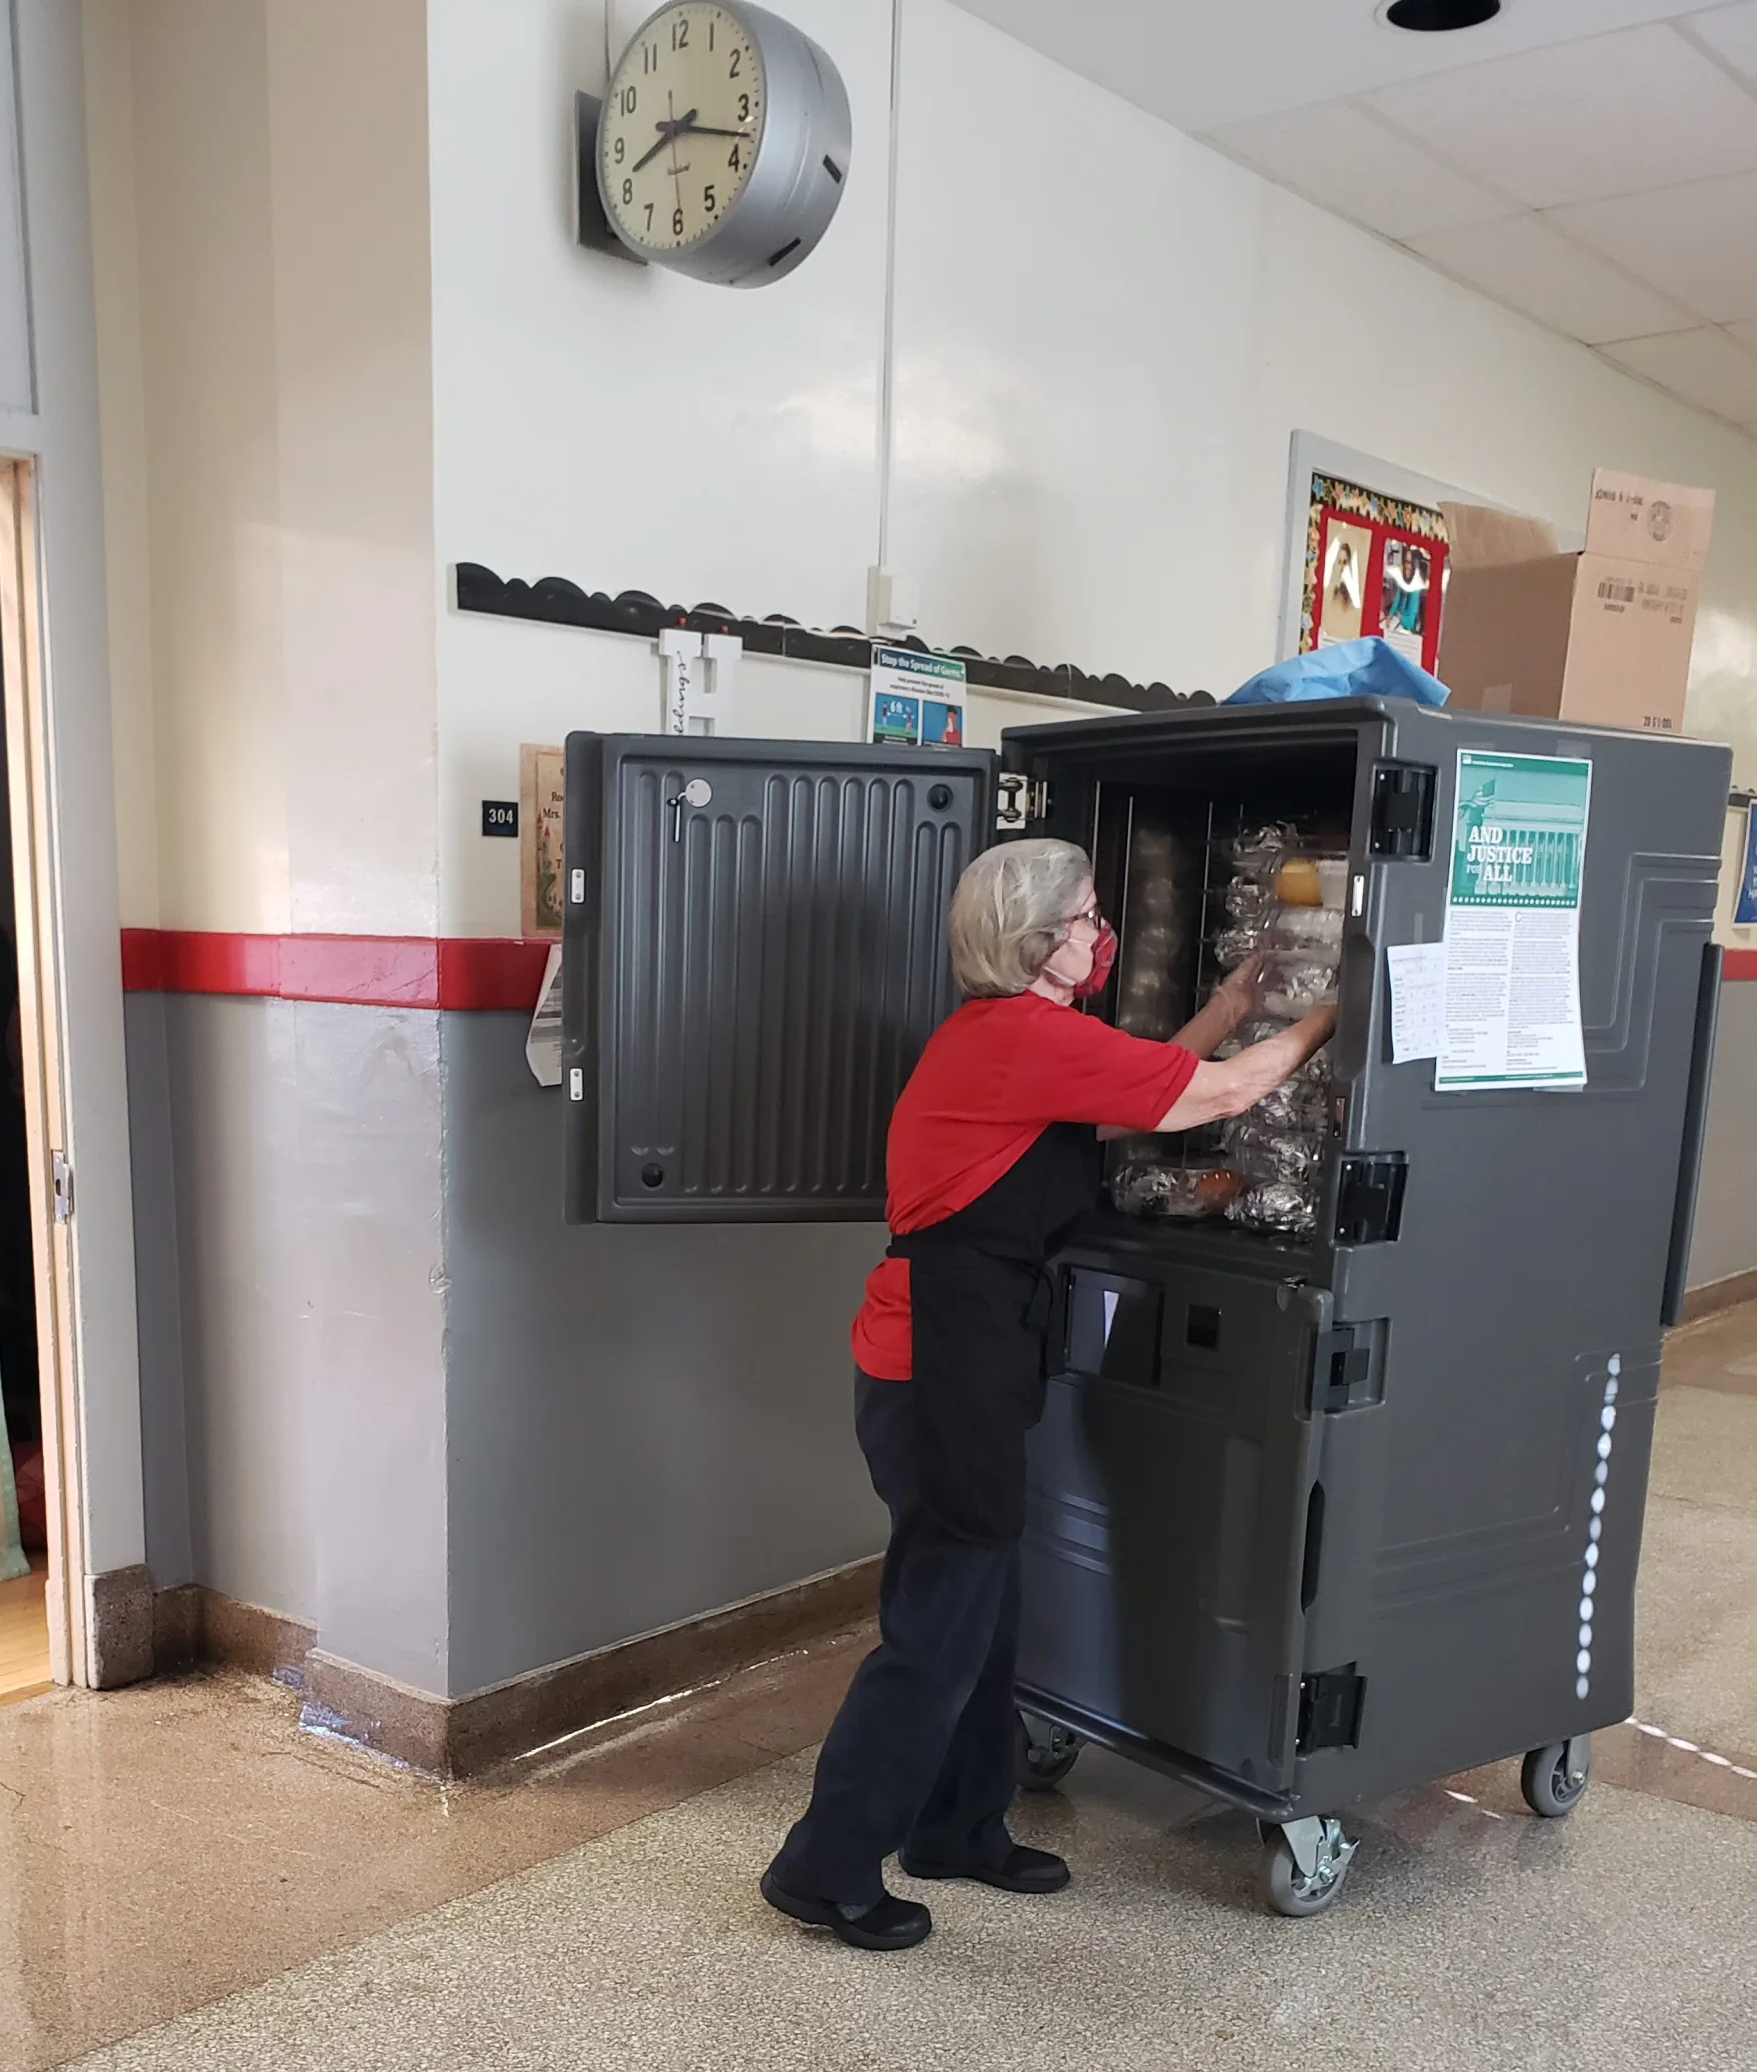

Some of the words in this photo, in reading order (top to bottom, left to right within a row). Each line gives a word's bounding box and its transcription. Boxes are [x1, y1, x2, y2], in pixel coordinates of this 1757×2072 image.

[672, 19, 689, 51] 12
[709, 22, 714, 52] 1
[644, 43, 657, 75] 11
[728, 48, 741, 79] 2
[620, 85, 637, 117] 10
[737, 93, 750, 122] 3
[614, 137, 624, 164] 9
[728, 144, 740, 173] 4
[622, 178, 633, 205] 8
[703, 184, 716, 212] 5
[644, 203, 654, 231] 7
[672, 208, 684, 236] 6
[881, 653, 897, 668] Stop
[898, 657, 910, 668] the
[910, 659, 933, 673] Spread
[933, 664, 940, 674] of
[940, 666, 962, 679] Germs
[488, 808, 514, 825] 304
[543, 807, 561, 819] Mrs.
[1468, 825, 1503, 844] AND
[1467, 845, 1533, 865] JUSTICE
[1483, 864, 1513, 882] ALL
